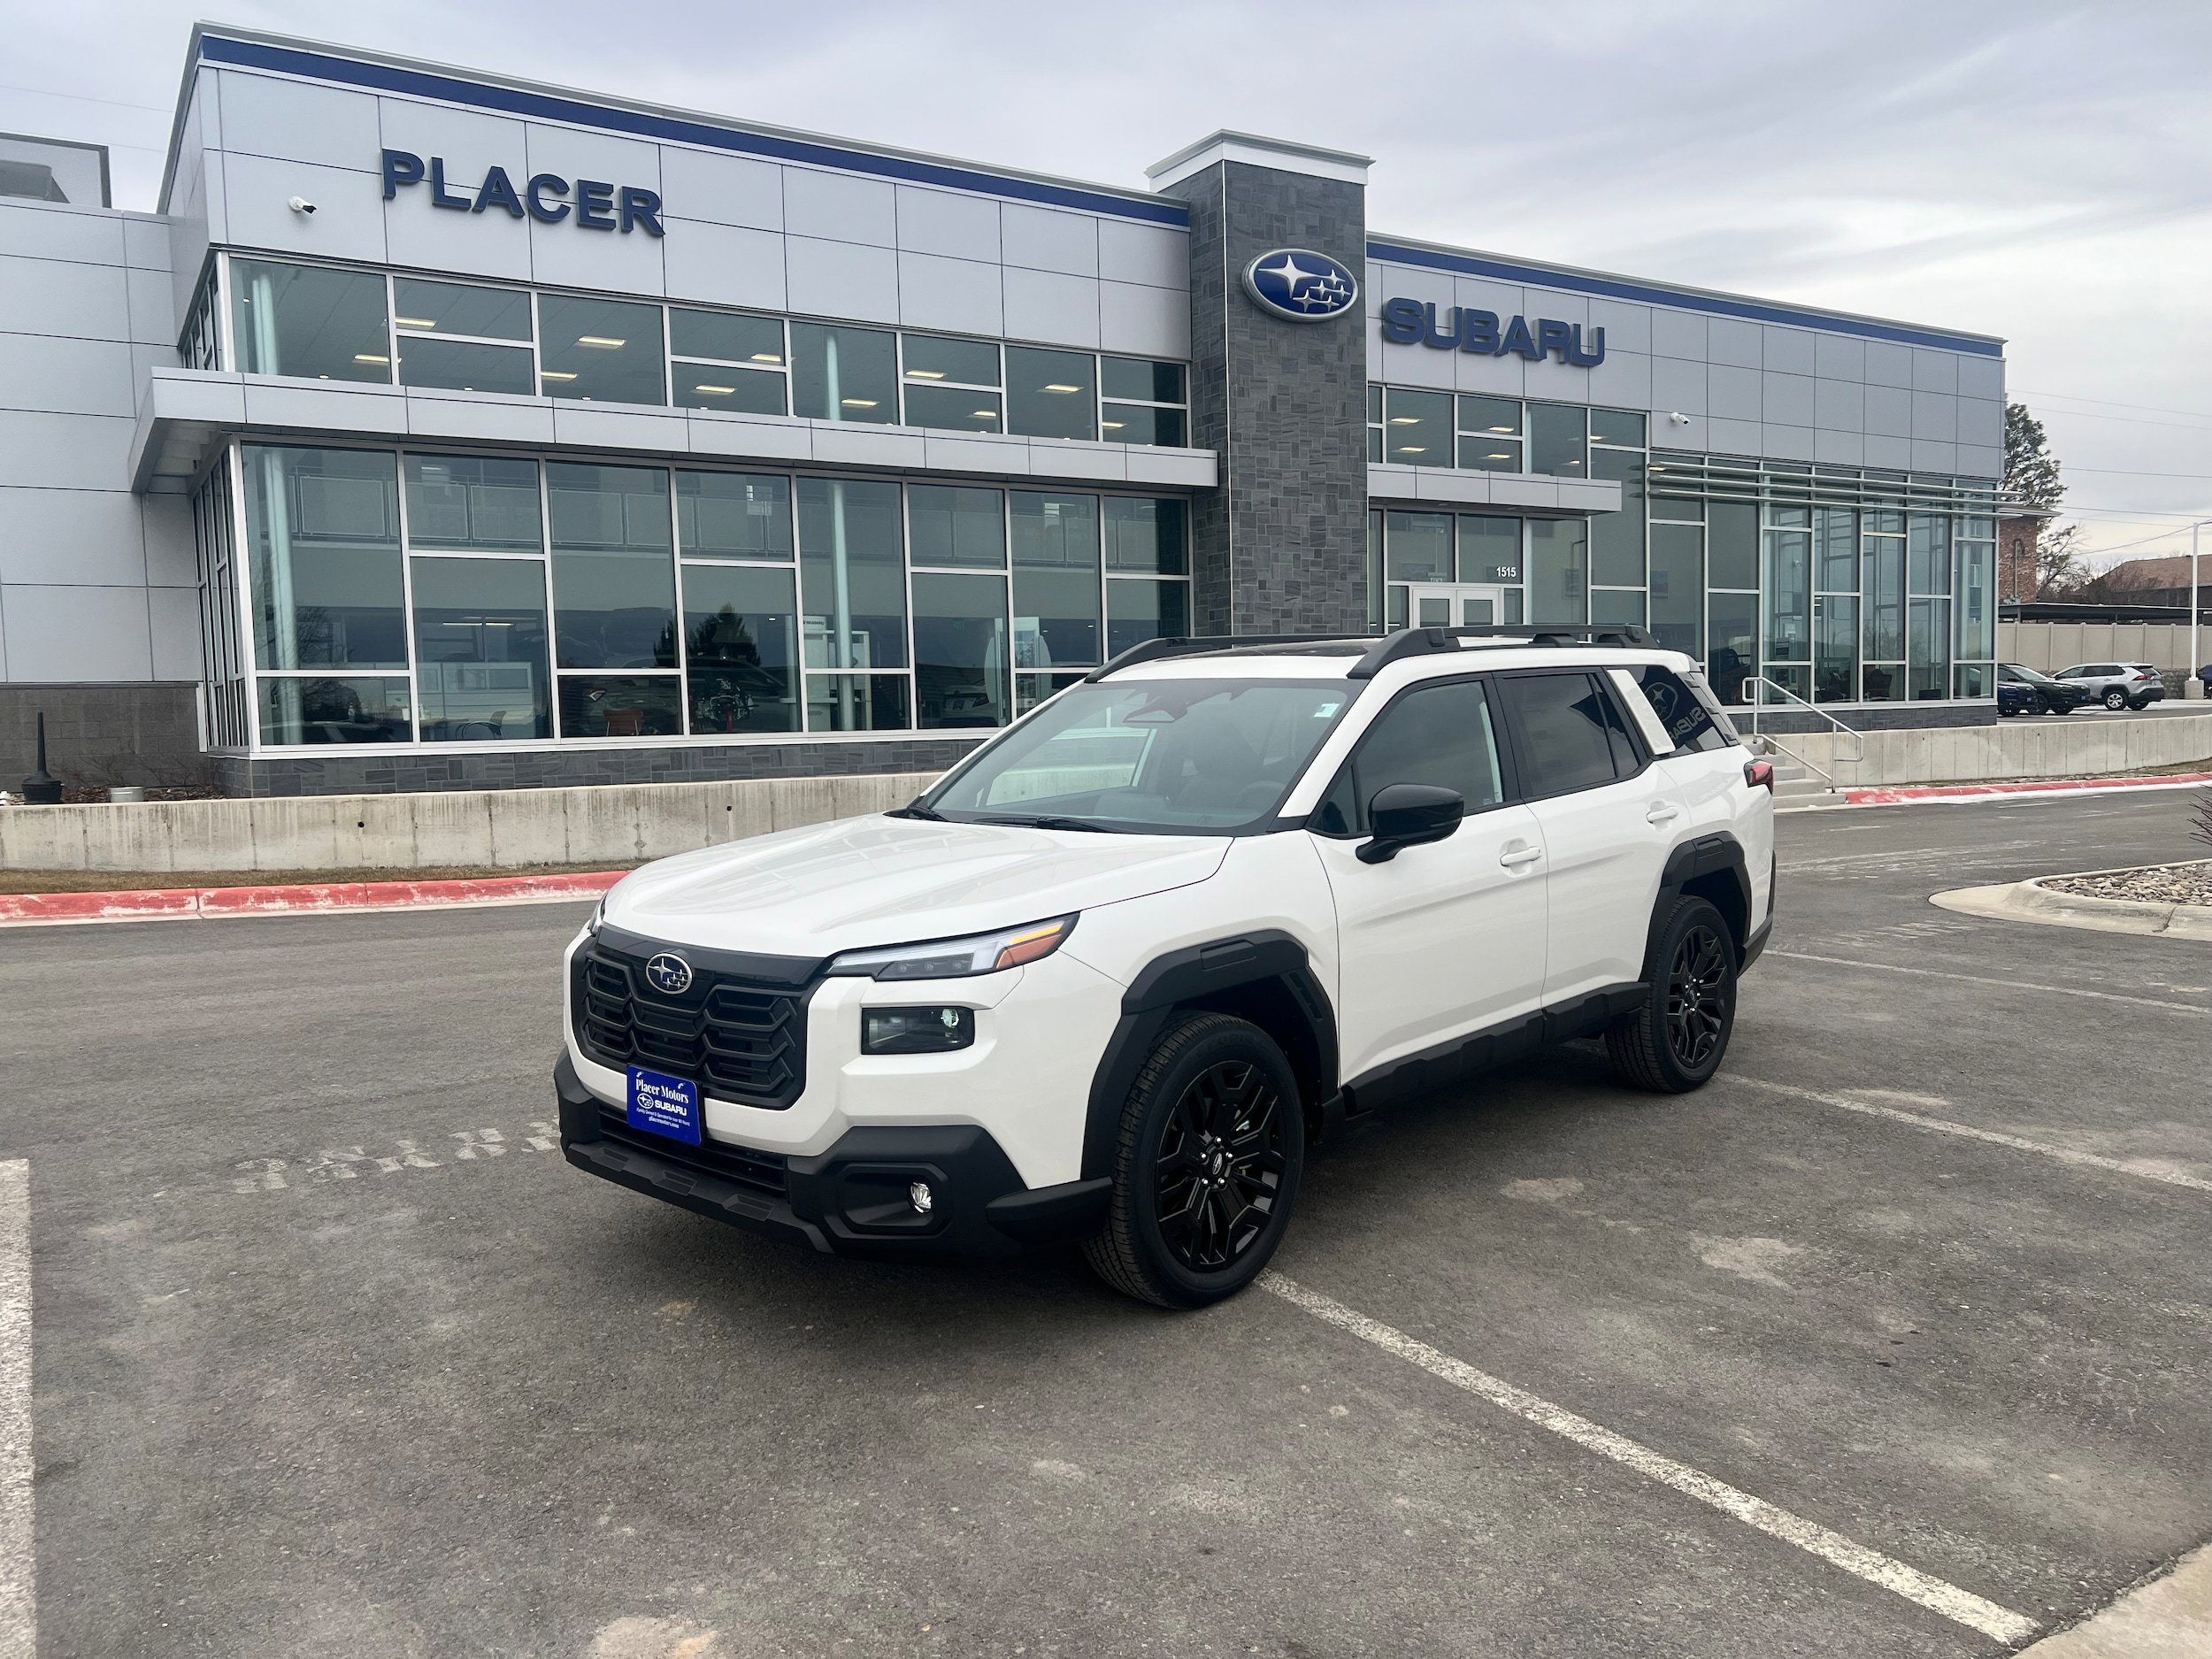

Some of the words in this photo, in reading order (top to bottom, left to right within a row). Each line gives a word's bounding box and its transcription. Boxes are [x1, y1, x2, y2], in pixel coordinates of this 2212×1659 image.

[381, 148, 666, 237] PLACER
[1381, 297, 1605, 367] SUBARU
[1496, 566, 1517, 578] 1515
[635, 1079, 660, 1095] Placer
[661, 1086, 689, 1104] Motors
[655, 1100, 687, 1116] SUBARU
